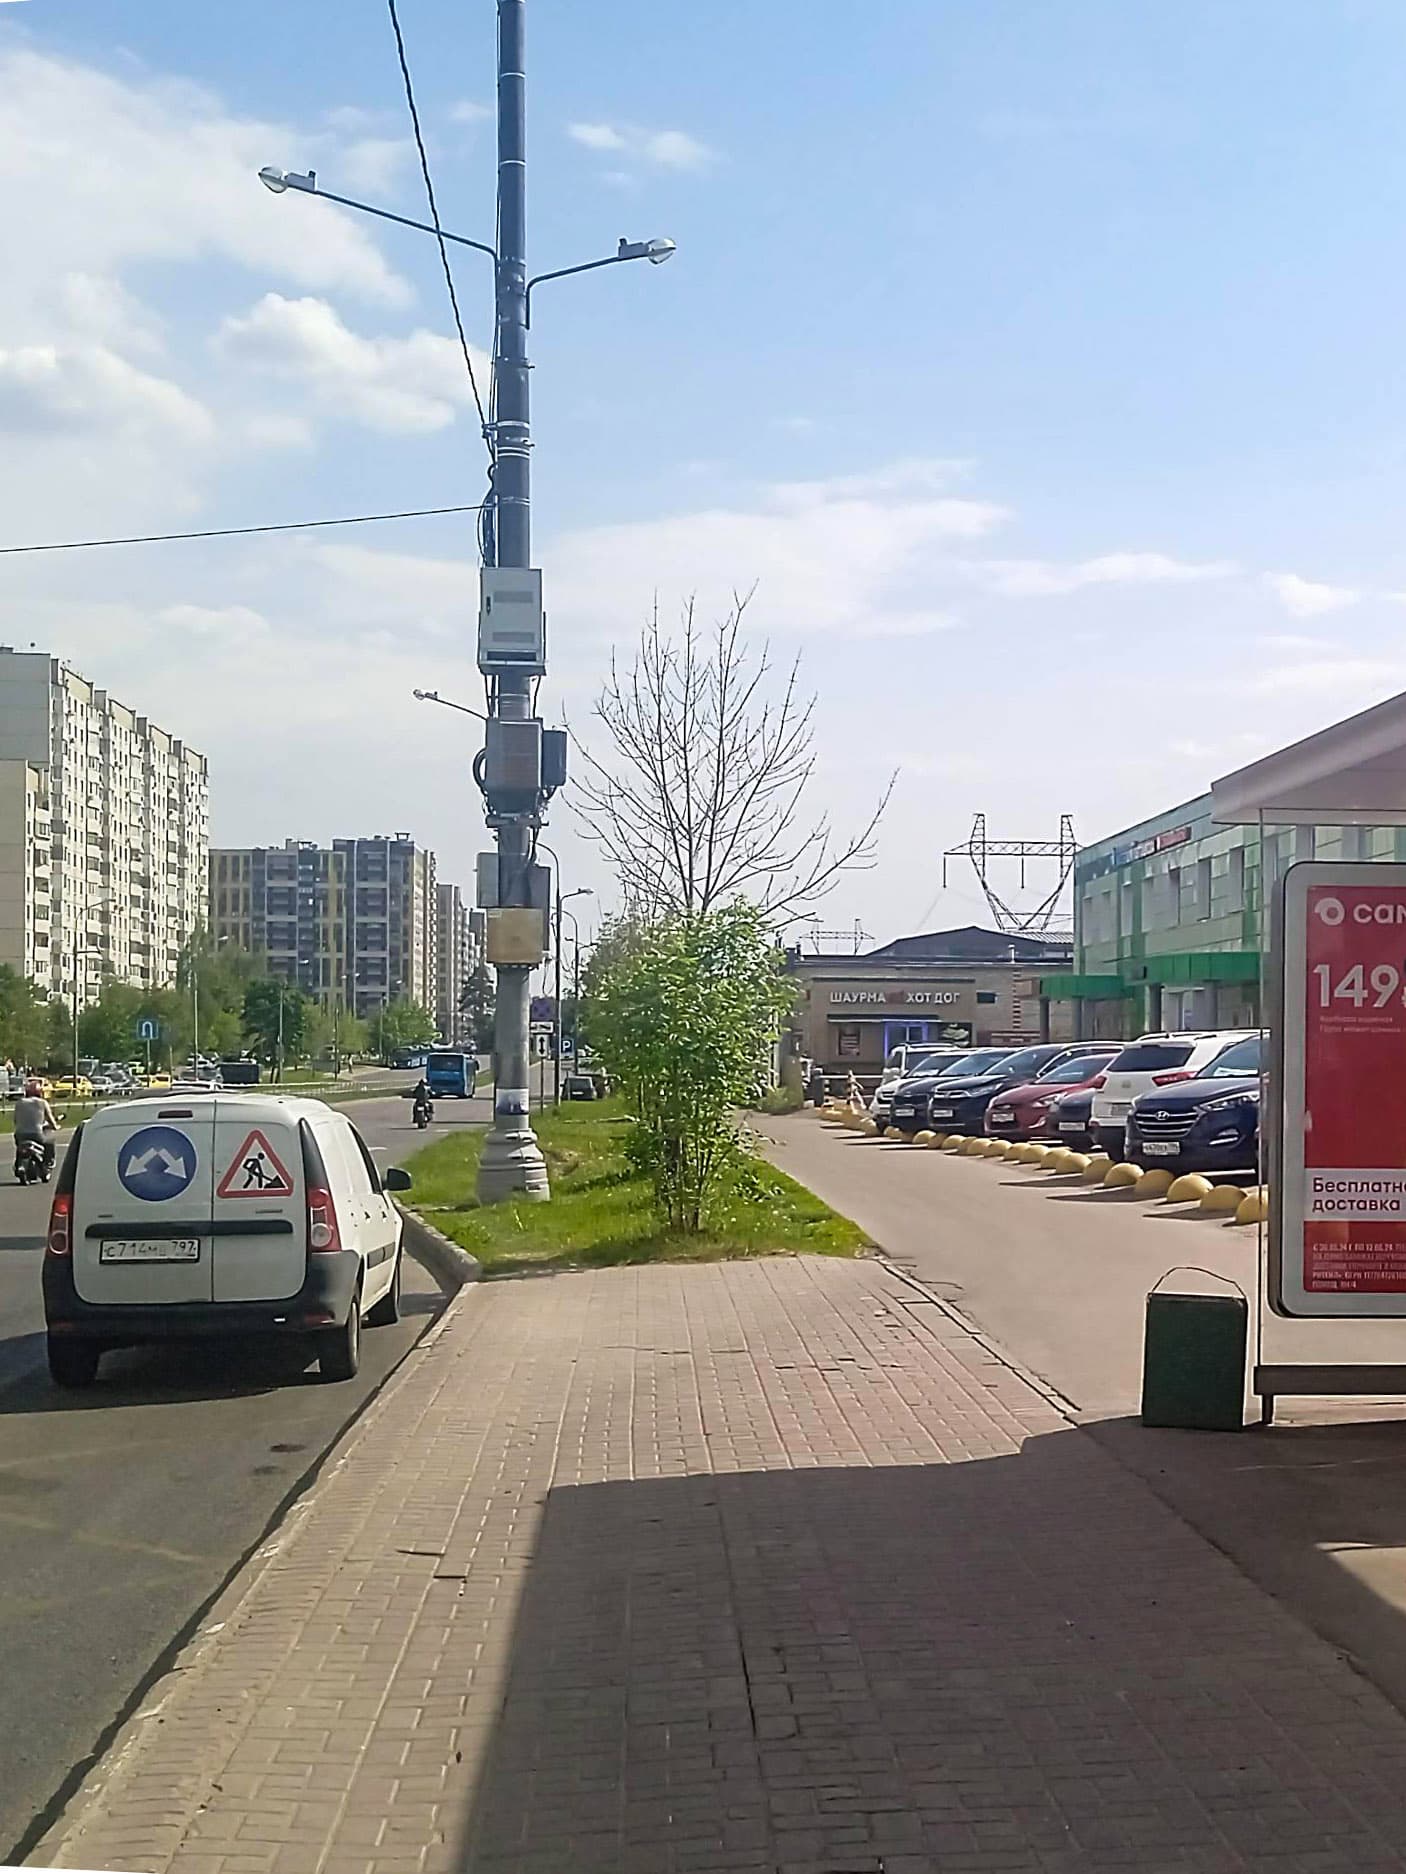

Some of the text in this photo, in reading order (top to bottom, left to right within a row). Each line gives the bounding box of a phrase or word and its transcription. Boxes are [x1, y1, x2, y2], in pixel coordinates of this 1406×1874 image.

[830, 991, 960, 1003] ШАУРМА ХОТ ДОГ
[562, 1040, 571, 1052] P
[1312, 1199, 1401, 1213] доставка
